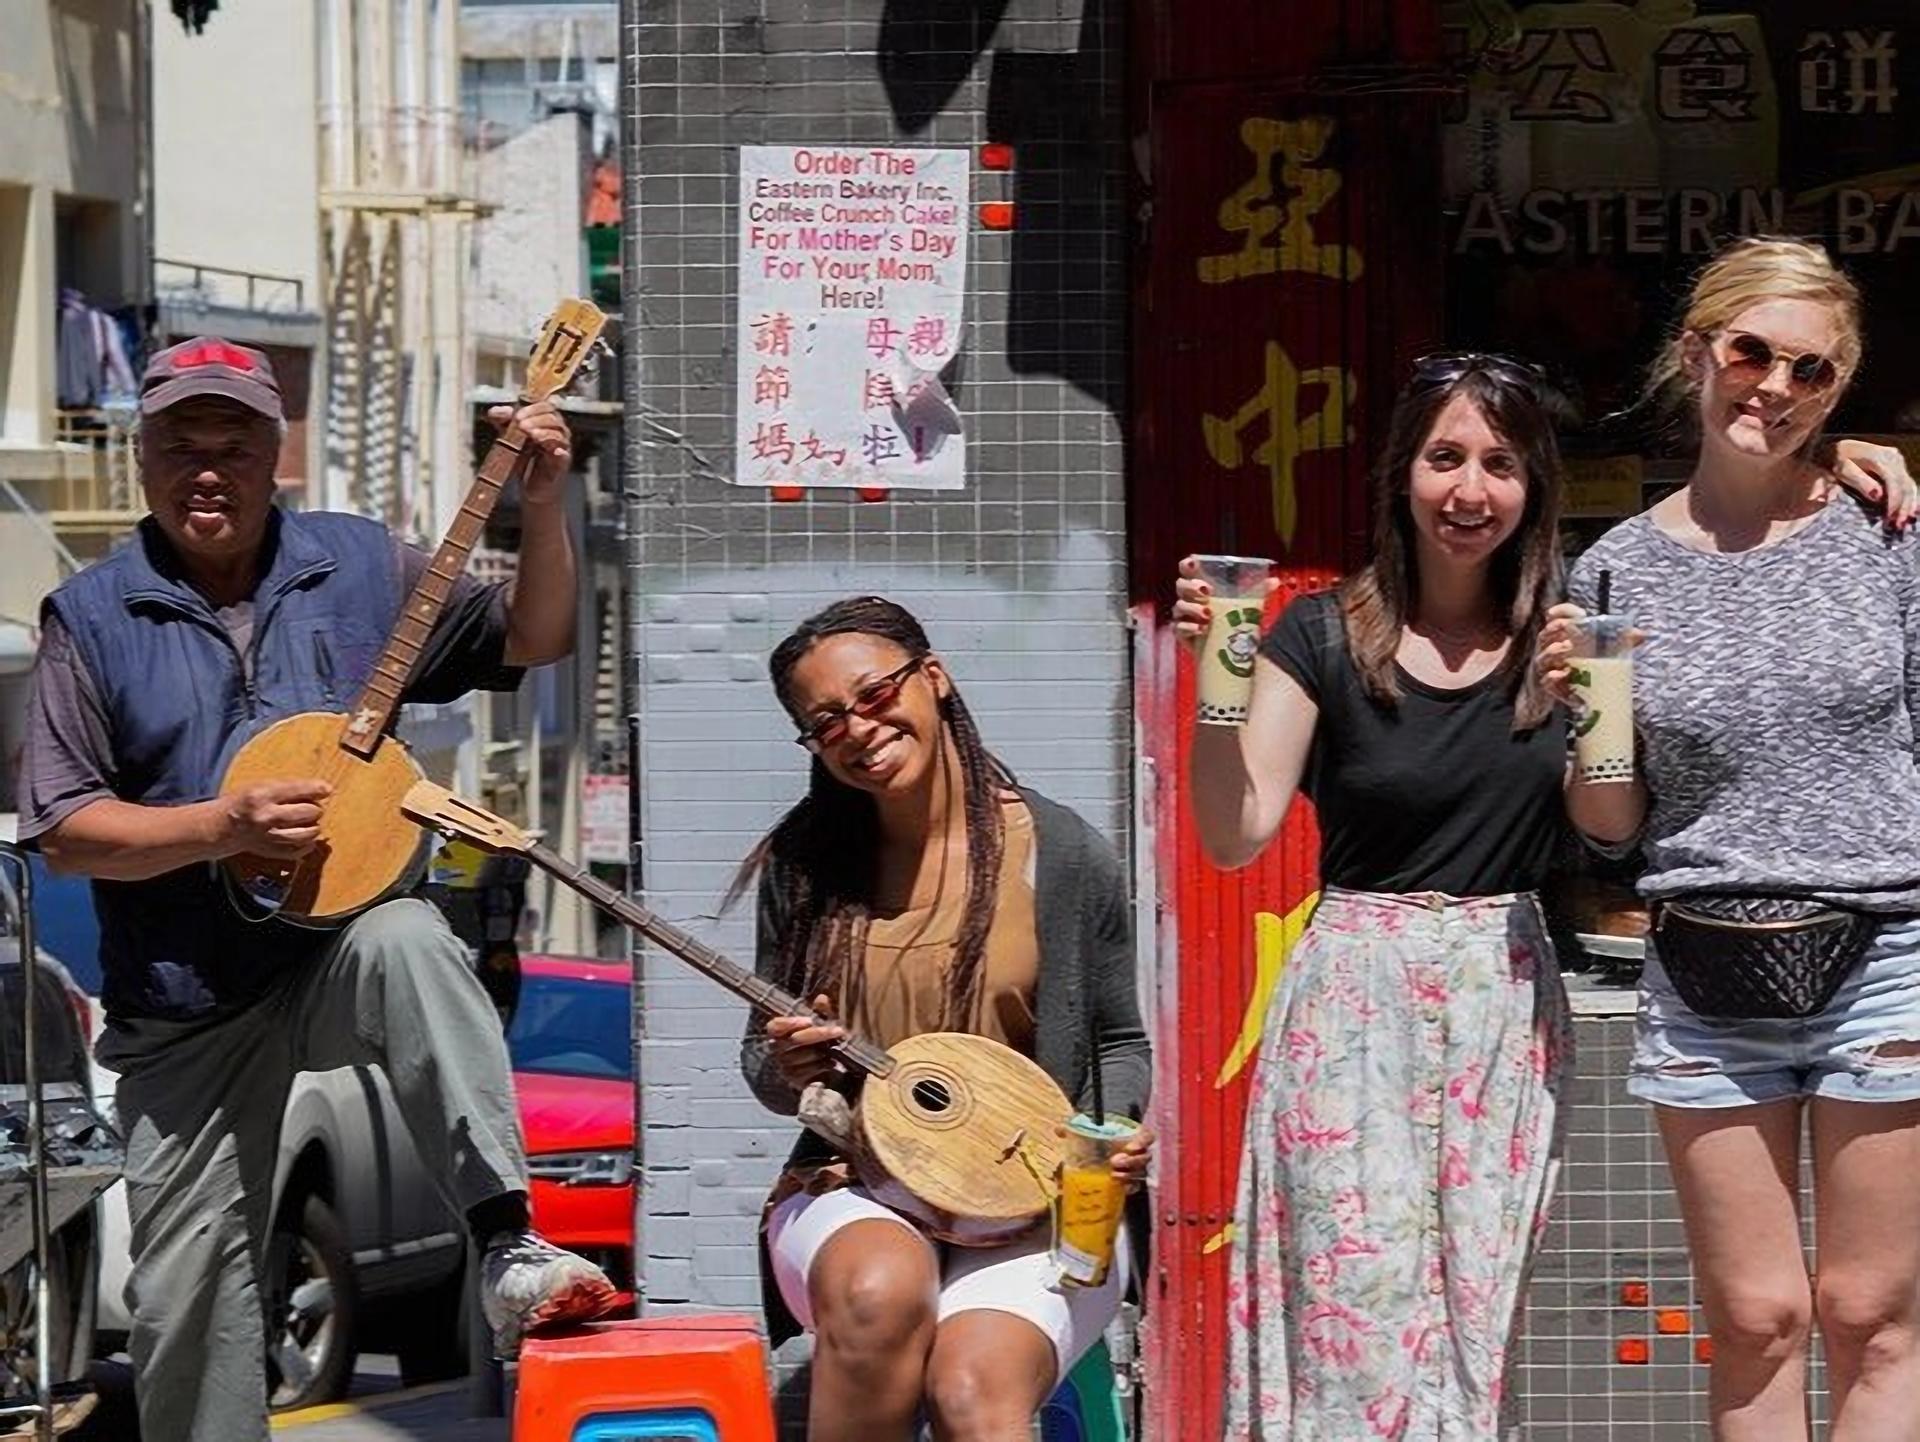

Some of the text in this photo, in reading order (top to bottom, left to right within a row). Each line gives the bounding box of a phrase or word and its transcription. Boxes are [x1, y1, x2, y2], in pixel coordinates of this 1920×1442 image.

[794, 150, 916, 175] Order The
[755, 178, 833, 199] Eastern
[839, 180, 910, 204] Bakery
[748, 202, 957, 225] Coffee Crunch Cake!
[751, 227, 956, 258] For Mother's Day
[764, 256, 804, 279] For
[821, 286, 886, 309] Here!
